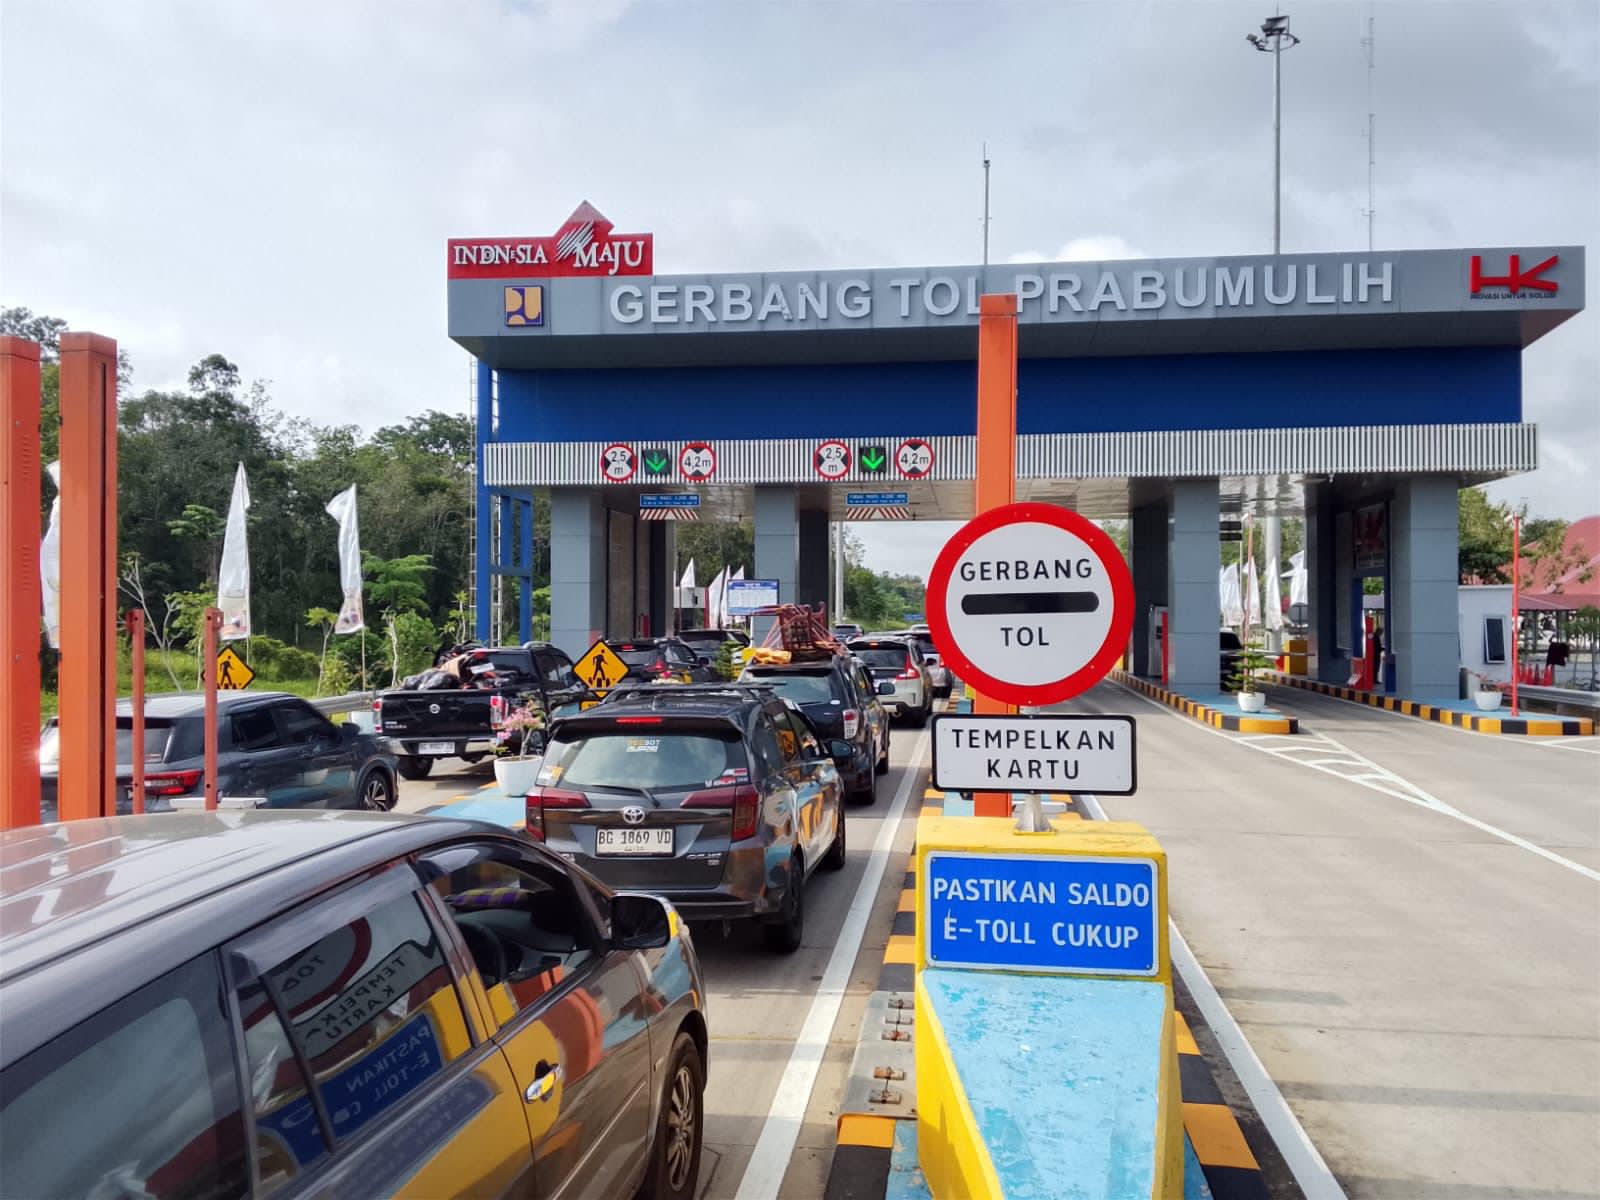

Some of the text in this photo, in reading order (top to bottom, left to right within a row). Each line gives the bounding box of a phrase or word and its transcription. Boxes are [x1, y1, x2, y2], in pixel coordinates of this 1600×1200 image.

[573, 241, 645, 276] MAJU
[1470, 254, 1558, 294] HK
[610, 262, 1394, 324] GERBANG TOL PRABUMULIH
[610, 450, 627, 464] 2,5
[825, 447, 842, 461] 2,5
[614, 467, 624, 475] m
[828, 464, 838, 472] m
[960, 558, 1093, 582] GERBANG
[1000, 626, 1050, 647] TOL
[951, 728, 1115, 750] TEMPELKAN
[987, 758, 1080, 780] KARTU
[598, 831, 672, 845] BG 1869 VD
[933, 877, 1150, 907] PASTIKAN SALDO
[1051, 921, 1140, 949] CUKUP
